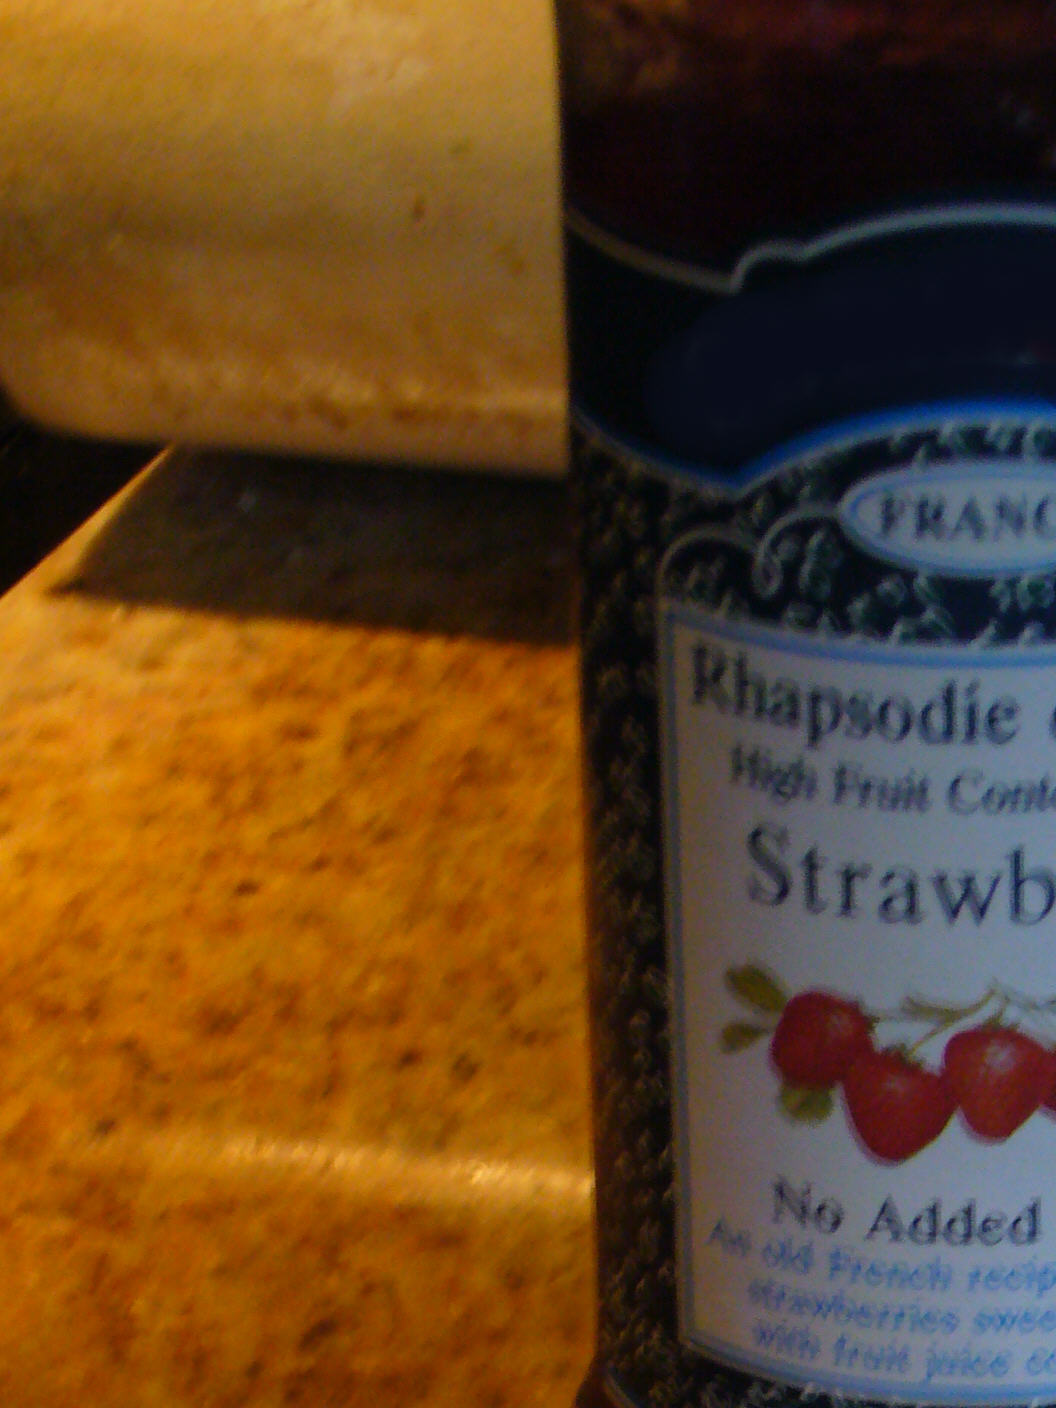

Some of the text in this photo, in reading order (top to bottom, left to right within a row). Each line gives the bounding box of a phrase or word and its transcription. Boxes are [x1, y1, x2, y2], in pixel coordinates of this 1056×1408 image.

[692, 643, 1023, 750] Rhapsodie
[729, 738, 819, 806] High
[832, 758, 932, 813] Fruit
[770, 1174, 845, 1234] No
[864, 1192, 1044, 1247] Added
[747, 1275, 962, 1335] strawberries
[828, 1246, 953, 1291] French
